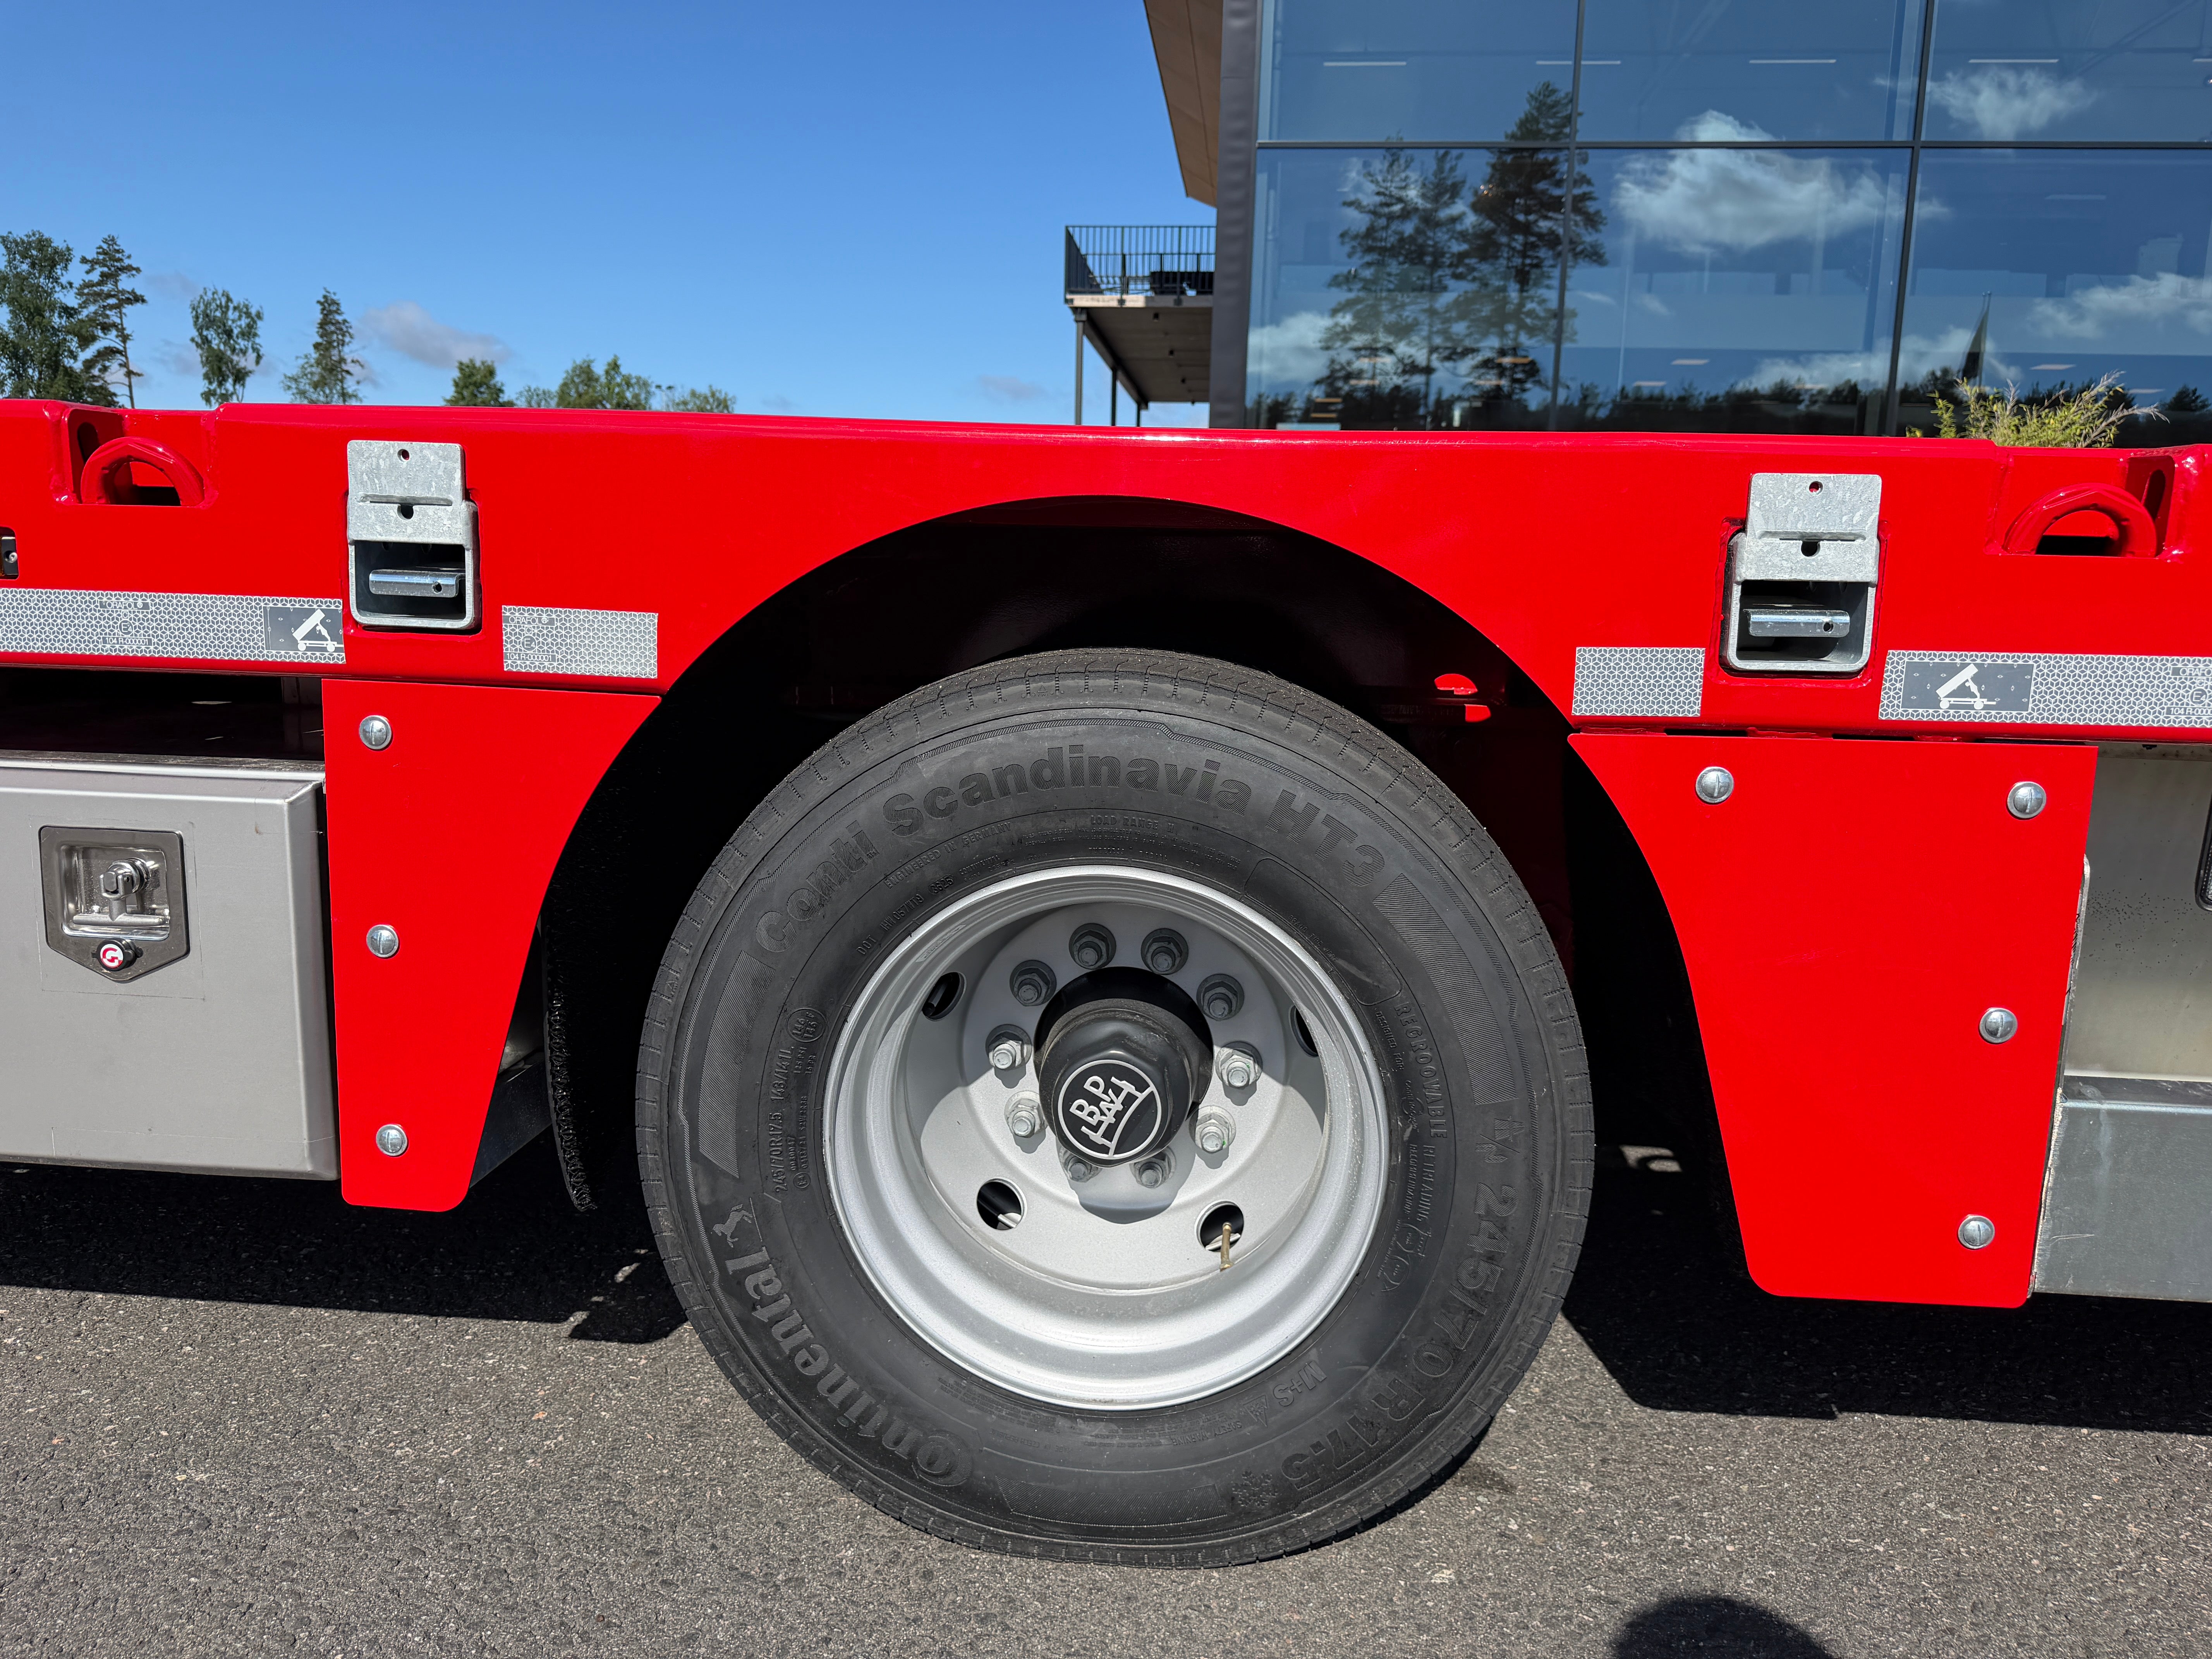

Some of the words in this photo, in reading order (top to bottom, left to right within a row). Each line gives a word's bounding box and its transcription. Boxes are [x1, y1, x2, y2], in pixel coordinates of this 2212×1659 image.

[122, 623, 132, 632] E4
[524, 639, 535, 648] E4
[2193, 692, 2206, 701] E4
[755, 819, 878, 953] Conti
[881, 744, 1253, 836] Scandinavia
[1270, 790, 1386, 887] HT3
[883, 848, 942, 890] ENGINEERED
[944, 840, 957, 854] IN
[961, 821, 1012, 847] GERMANY
[855, 933, 877, 957] DOT
[1374, 1009, 1398, 1050] DESIGNED
[770, 1042, 794, 1104] 143/141L
[1395, 1000, 1447, 1139] REGROOVABLE
[768, 1110, 789, 1193] 245/70R17.5
[1415, 1144, 1436, 1222] RETREADING
[1412, 1182, 1517, 1378] 245/70
[725, 1246, 973, 1487] Continental
[1273, 1362, 1328, 1408] M+S
[1170, 1430, 1209, 1447] WARNING
[1211, 1419, 1243, 1437] SAFETY
